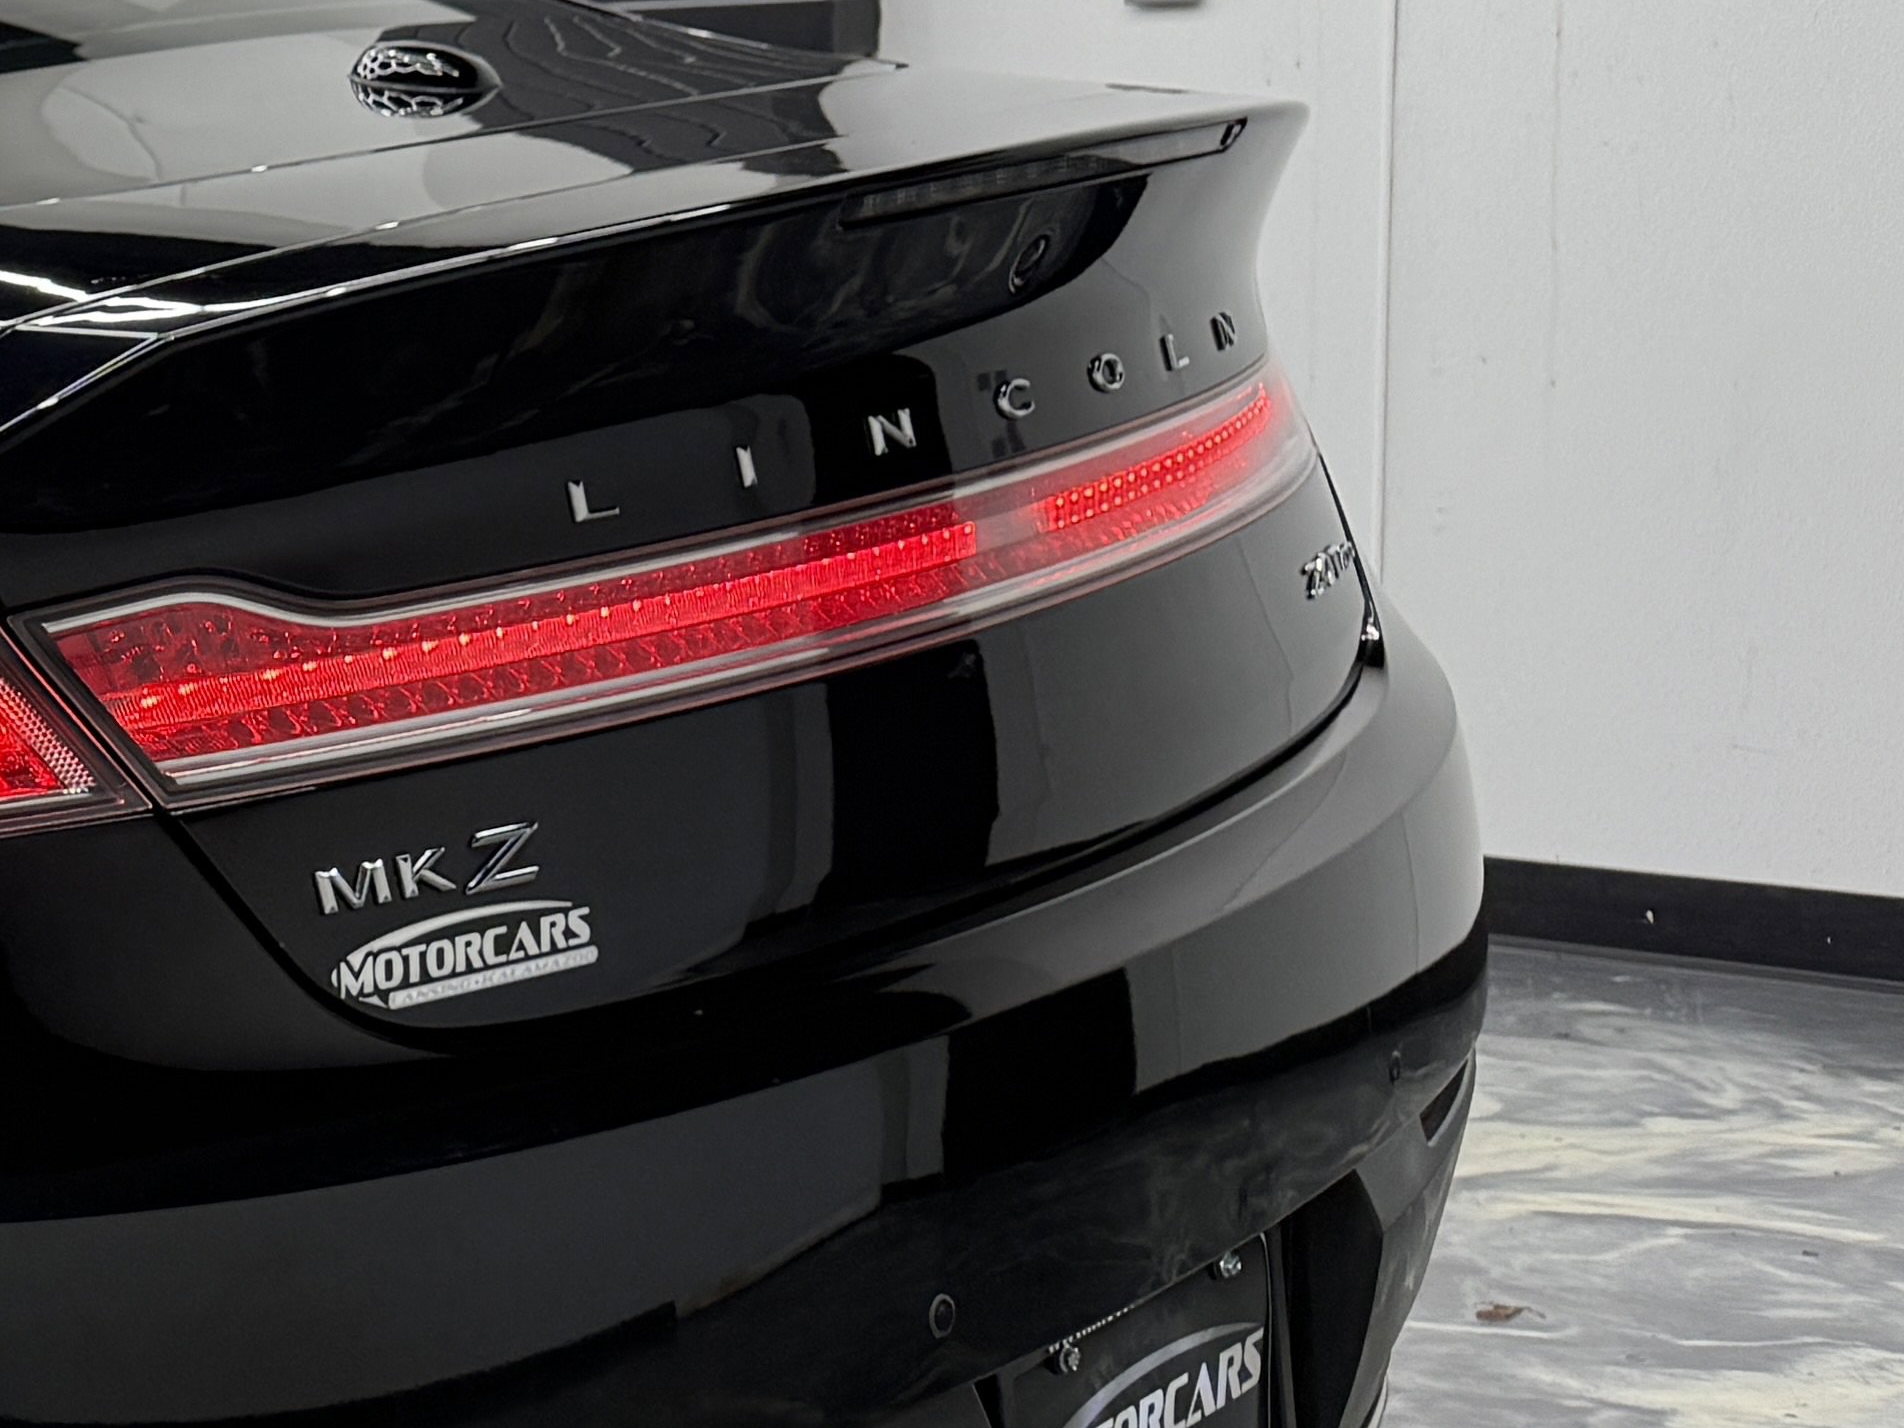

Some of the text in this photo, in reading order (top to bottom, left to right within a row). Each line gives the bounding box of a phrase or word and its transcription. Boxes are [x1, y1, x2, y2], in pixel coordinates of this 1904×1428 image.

[567, 312, 1238, 523] LINCOLN
[314, 821, 540, 915] MKZ
[339, 906, 591, 999] MOTORCARS
